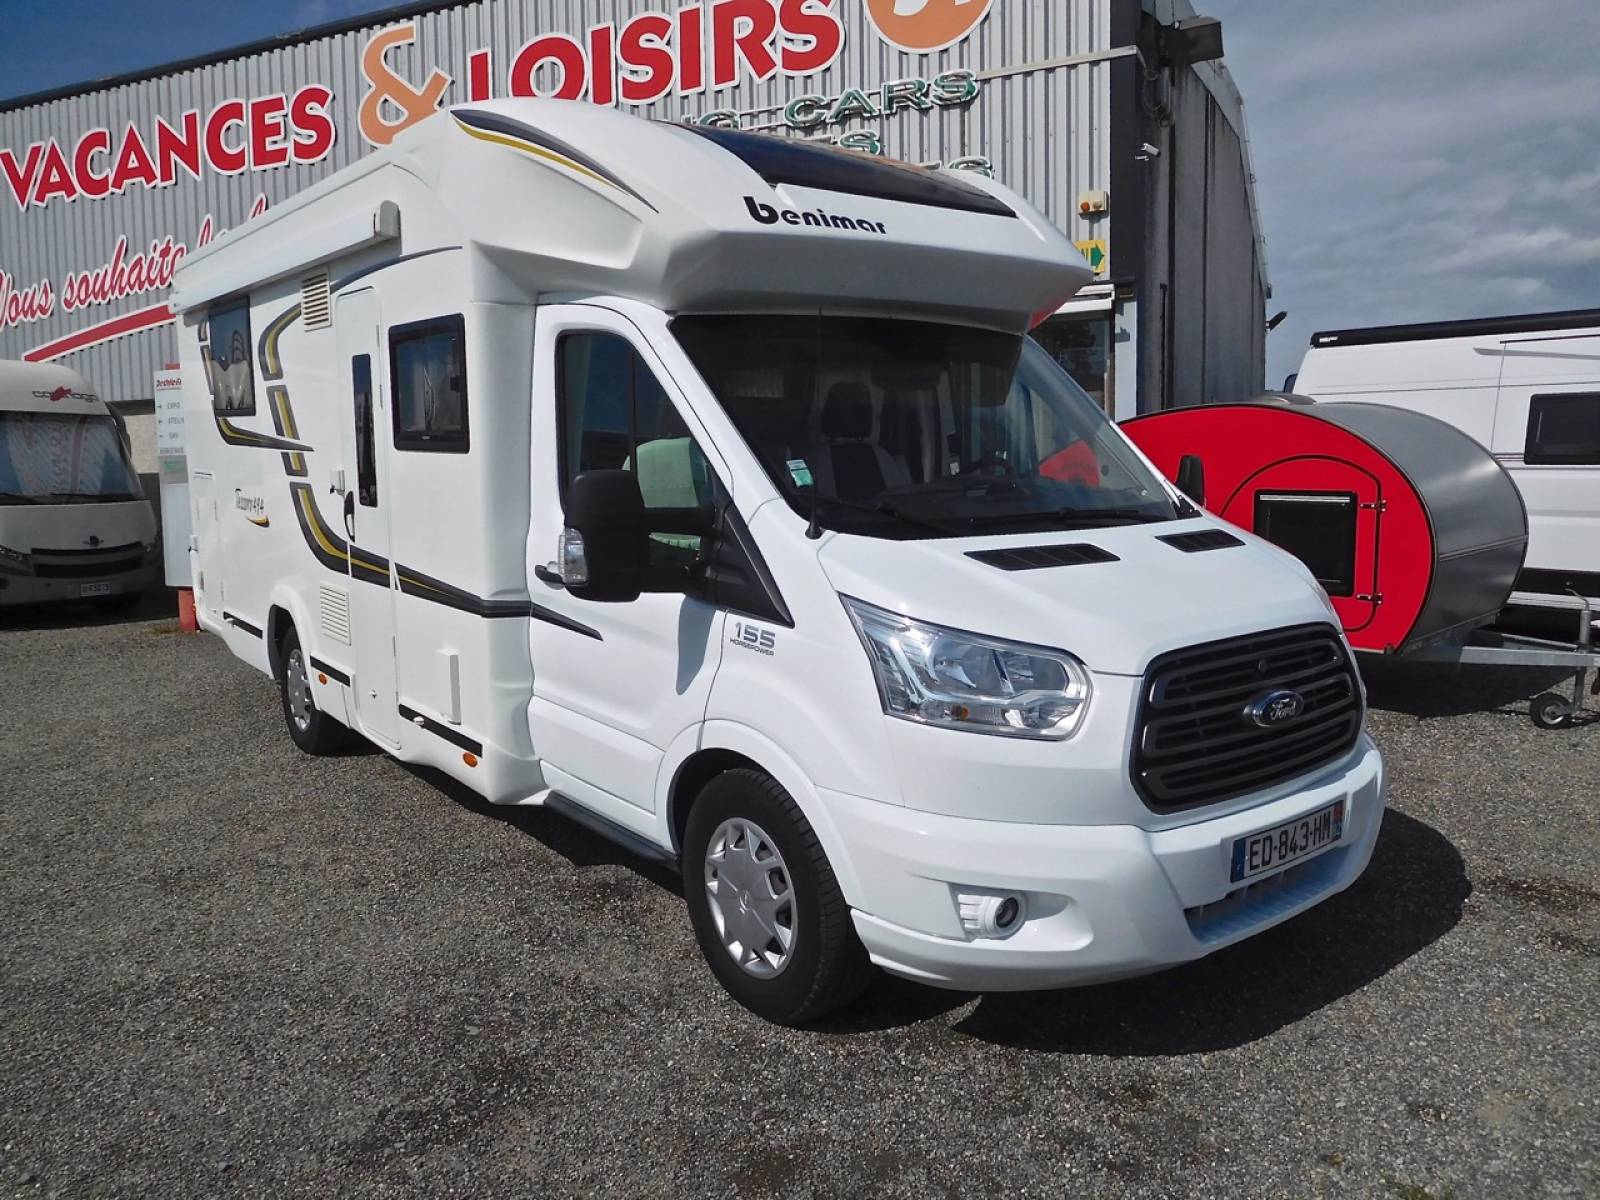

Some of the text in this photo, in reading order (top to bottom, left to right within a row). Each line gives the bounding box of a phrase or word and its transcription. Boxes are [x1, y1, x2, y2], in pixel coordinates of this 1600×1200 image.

[1, 86, 333, 208] VACANCES
[361, 25, 450, 146] &
[784, 69, 979, 127] CARS
[743, 196, 887, 234] benimar
[735, 622, 776, 649] 155
[1270, 698, 1297, 720] Ford
